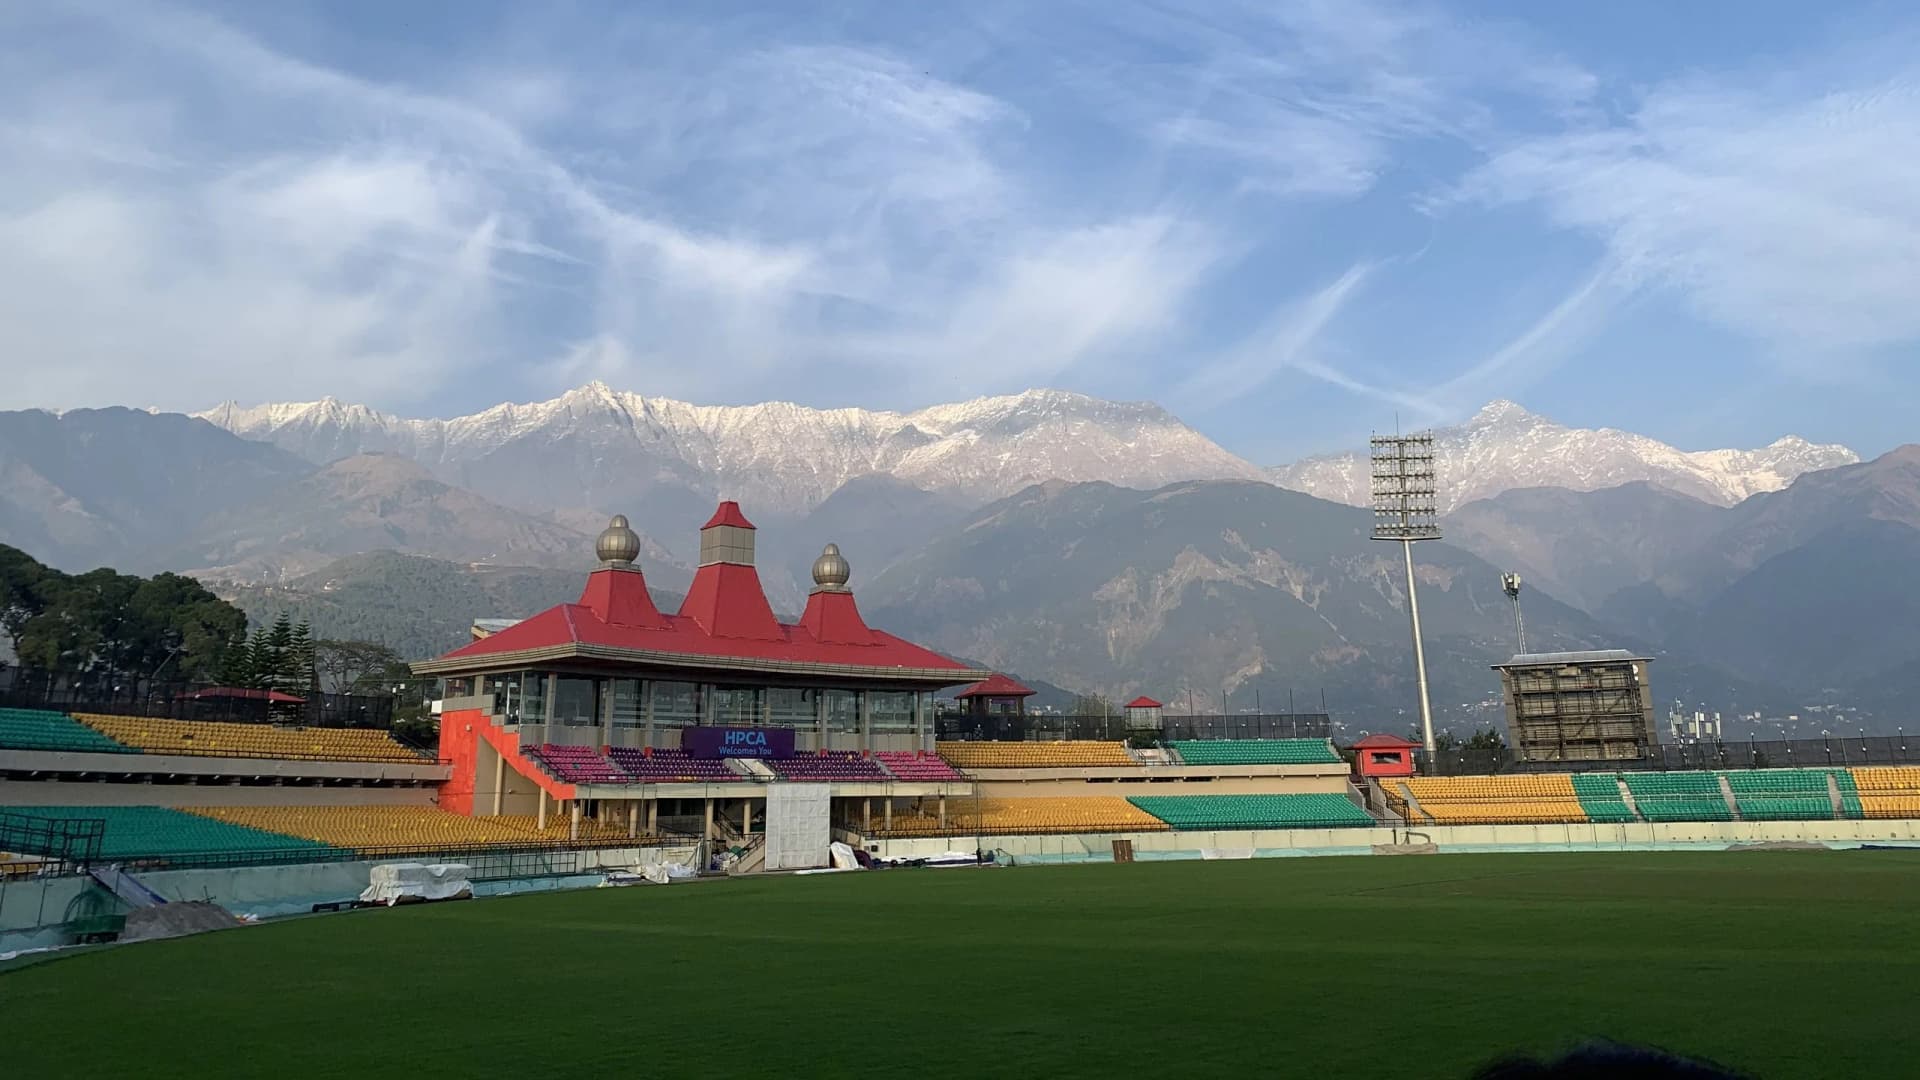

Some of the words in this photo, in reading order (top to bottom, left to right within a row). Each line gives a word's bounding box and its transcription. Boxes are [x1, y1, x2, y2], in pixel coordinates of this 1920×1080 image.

[724, 731, 767, 745] HPCA
[719, 746, 757, 755] Welcomes
[759, 746, 772, 755] You
